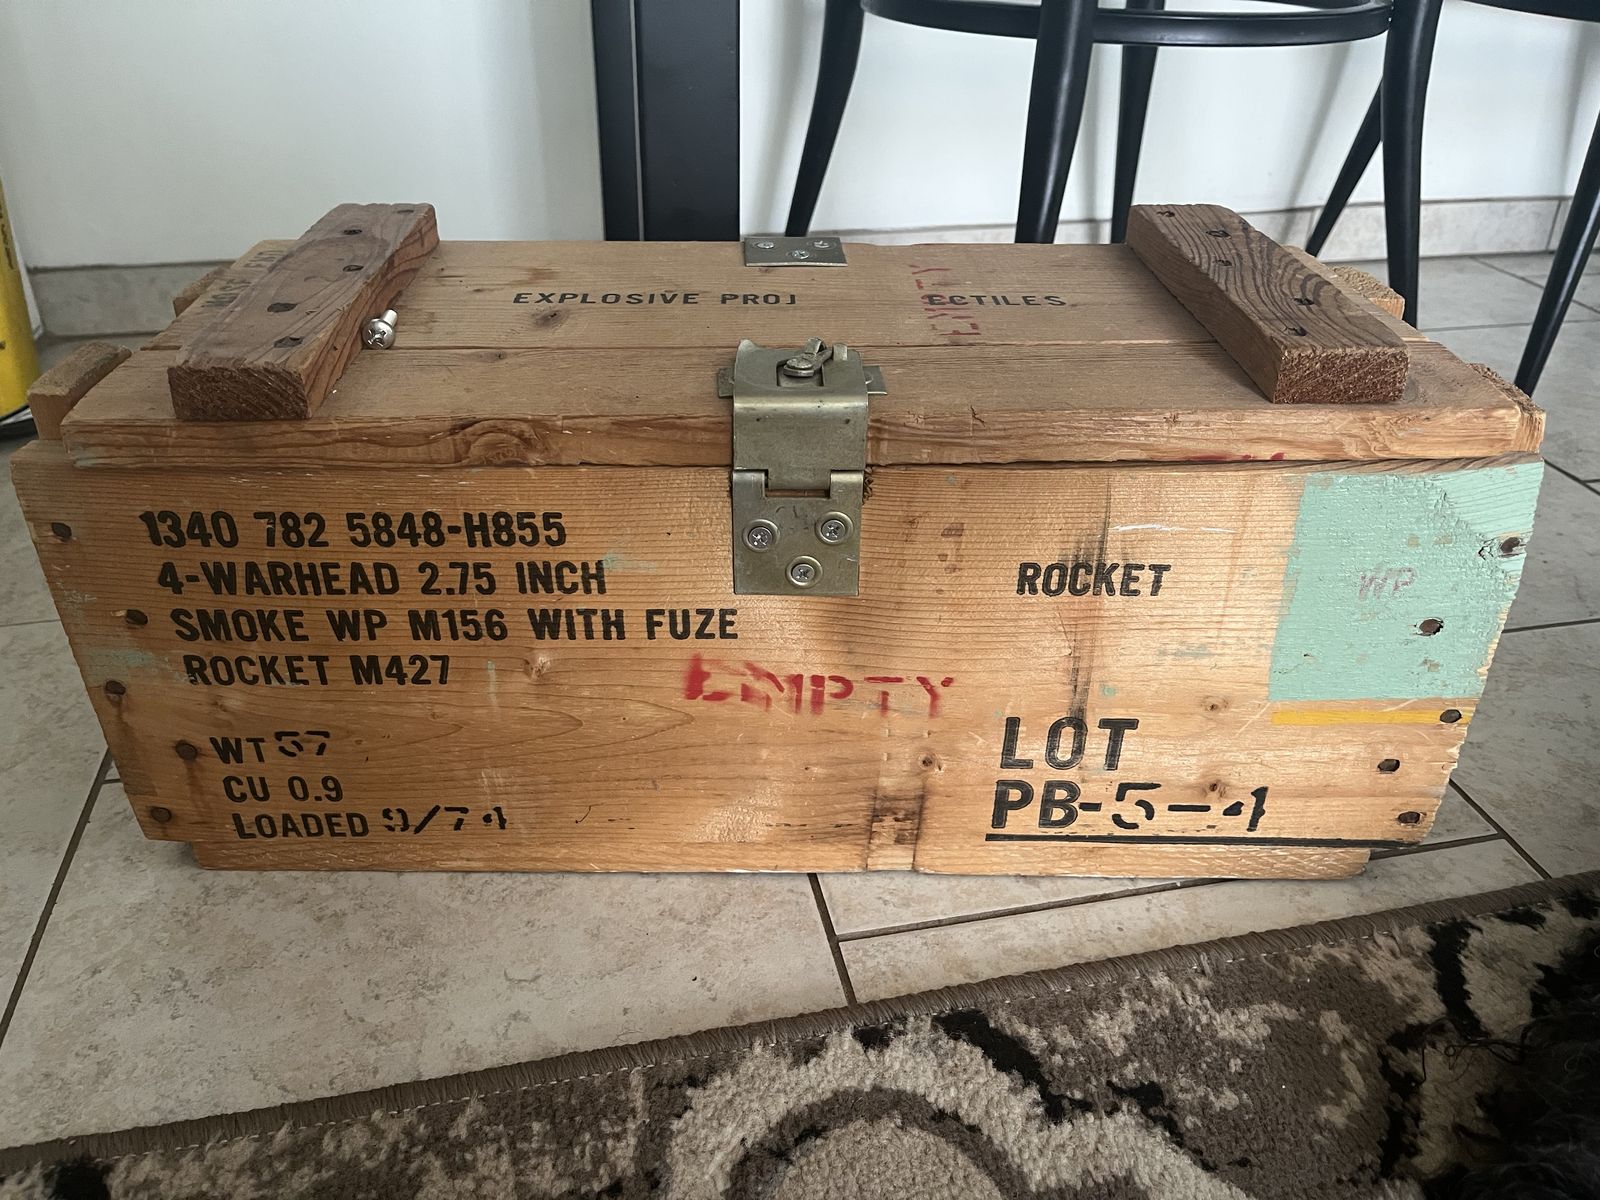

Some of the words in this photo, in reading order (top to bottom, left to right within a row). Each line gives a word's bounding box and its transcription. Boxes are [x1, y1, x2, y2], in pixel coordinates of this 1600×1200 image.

[513, 292, 700, 305] EXPLOSIVE
[720, 293, 796, 305] PROJ
[927, 294, 1067, 306] ECTILES
[138, 510, 239, 548] 1340
[253, 511, 329, 548] 782
[346, 511, 567, 548] 5848-H855
[158, 561, 400, 596] 4-WARHEAD
[417, 561, 497, 596] 2.75
[515, 560, 607, 595] INCH
[1016, 561, 1172, 598] ROCKET
[170, 608, 309, 643] SMOKE
[326, 609, 388, 642] WP
[407, 608, 508, 642] M156
[527, 608, 626, 641] WITH
[645, 608, 739, 640] FUZE
[183, 654, 329, 686] ROCKET
[350, 654, 450, 686] M427
[684, 653, 955, 719] EMPTY
[209, 736, 265, 764] WT
[274, 730, 331, 758] 57
[1000, 716, 1140, 771] LOT
[223, 775, 271, 802] CU
[287, 775, 344, 802] 0.9
[231, 812, 370, 840] LOADED
